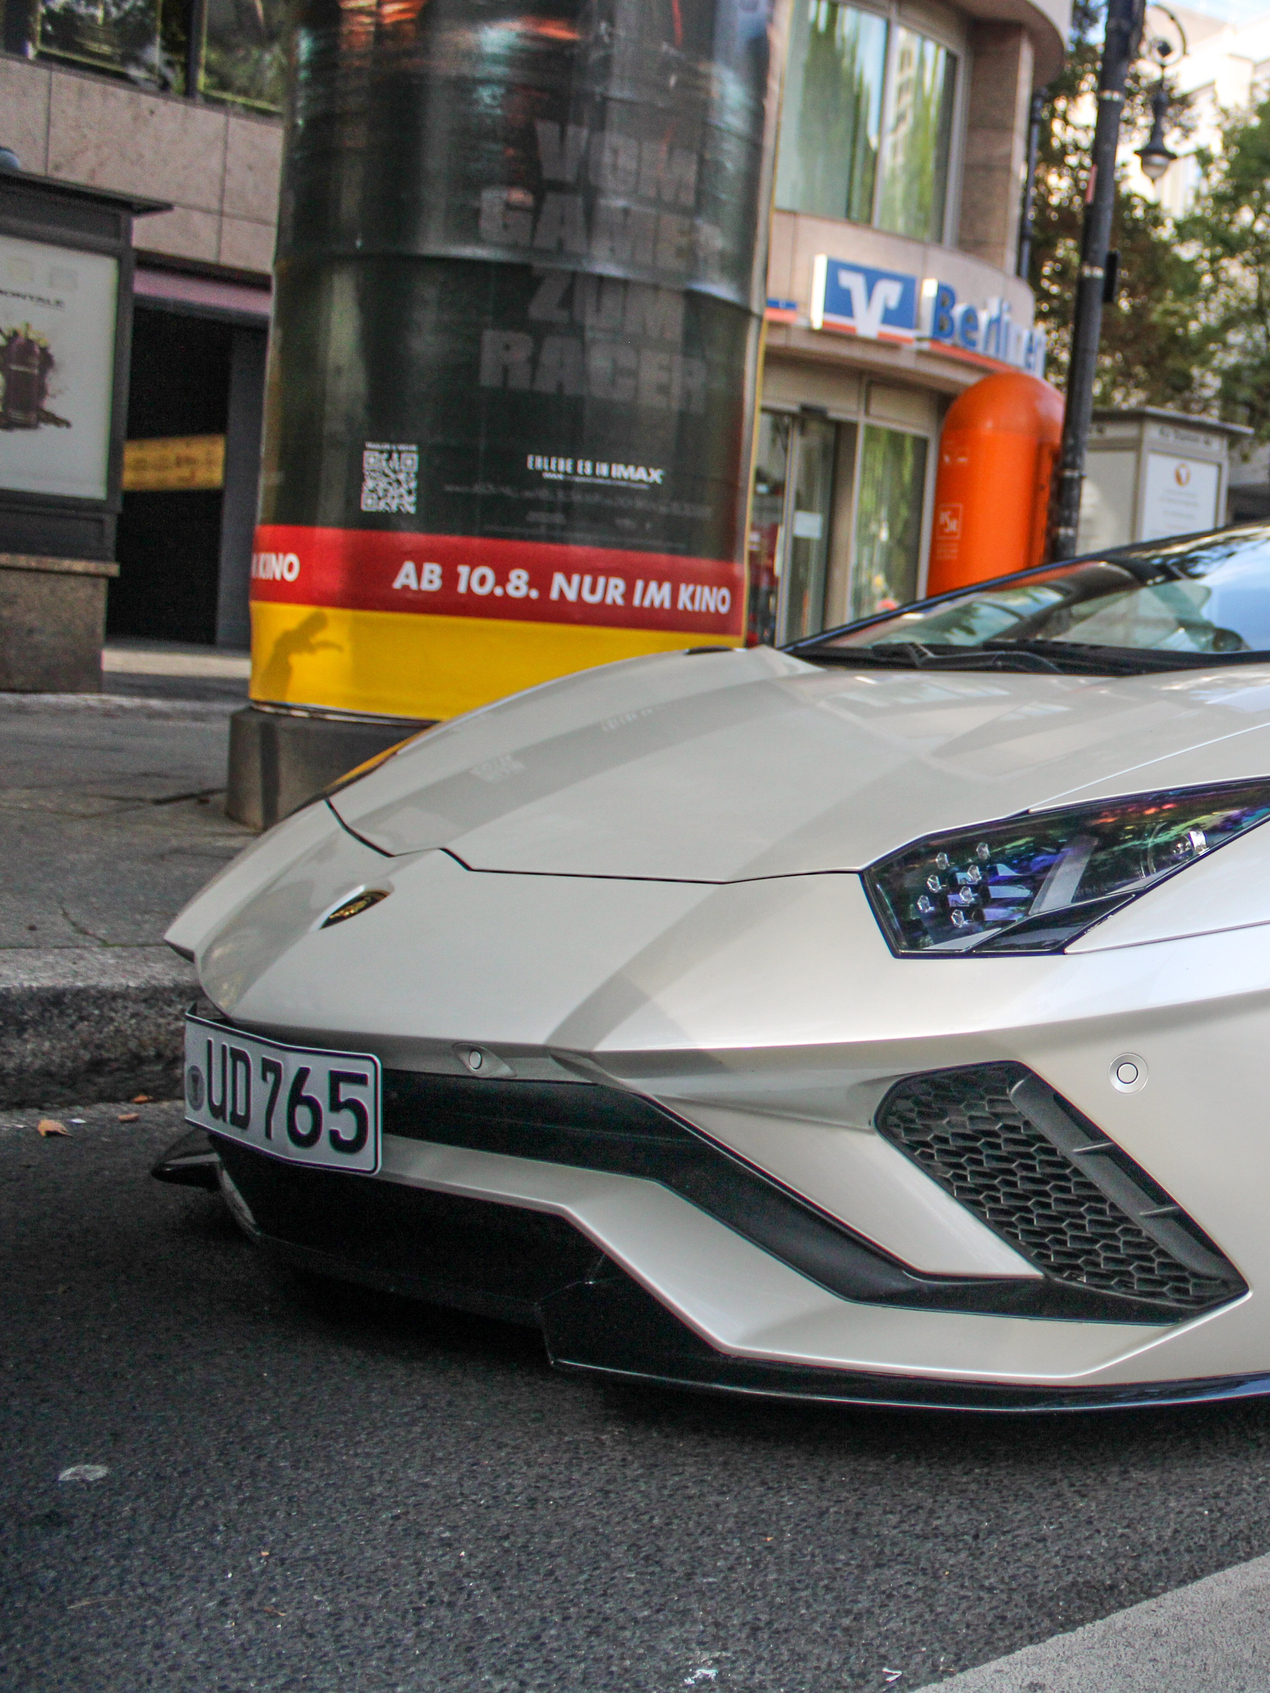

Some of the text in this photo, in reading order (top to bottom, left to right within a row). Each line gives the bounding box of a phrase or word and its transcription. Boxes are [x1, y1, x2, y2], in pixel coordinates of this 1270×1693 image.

[534, 119, 699, 207] VOM
[528, 261, 686, 341] ZUM
[479, 329, 707, 414] RACER
[527, 454, 574, 474] ERLEBE
[577, 459, 593, 476] ES
[596, 461, 609, 477] IN
[611, 463, 663, 484] IMAX
[392, 560, 731, 615] AB 10.8. NUR IM KINO
